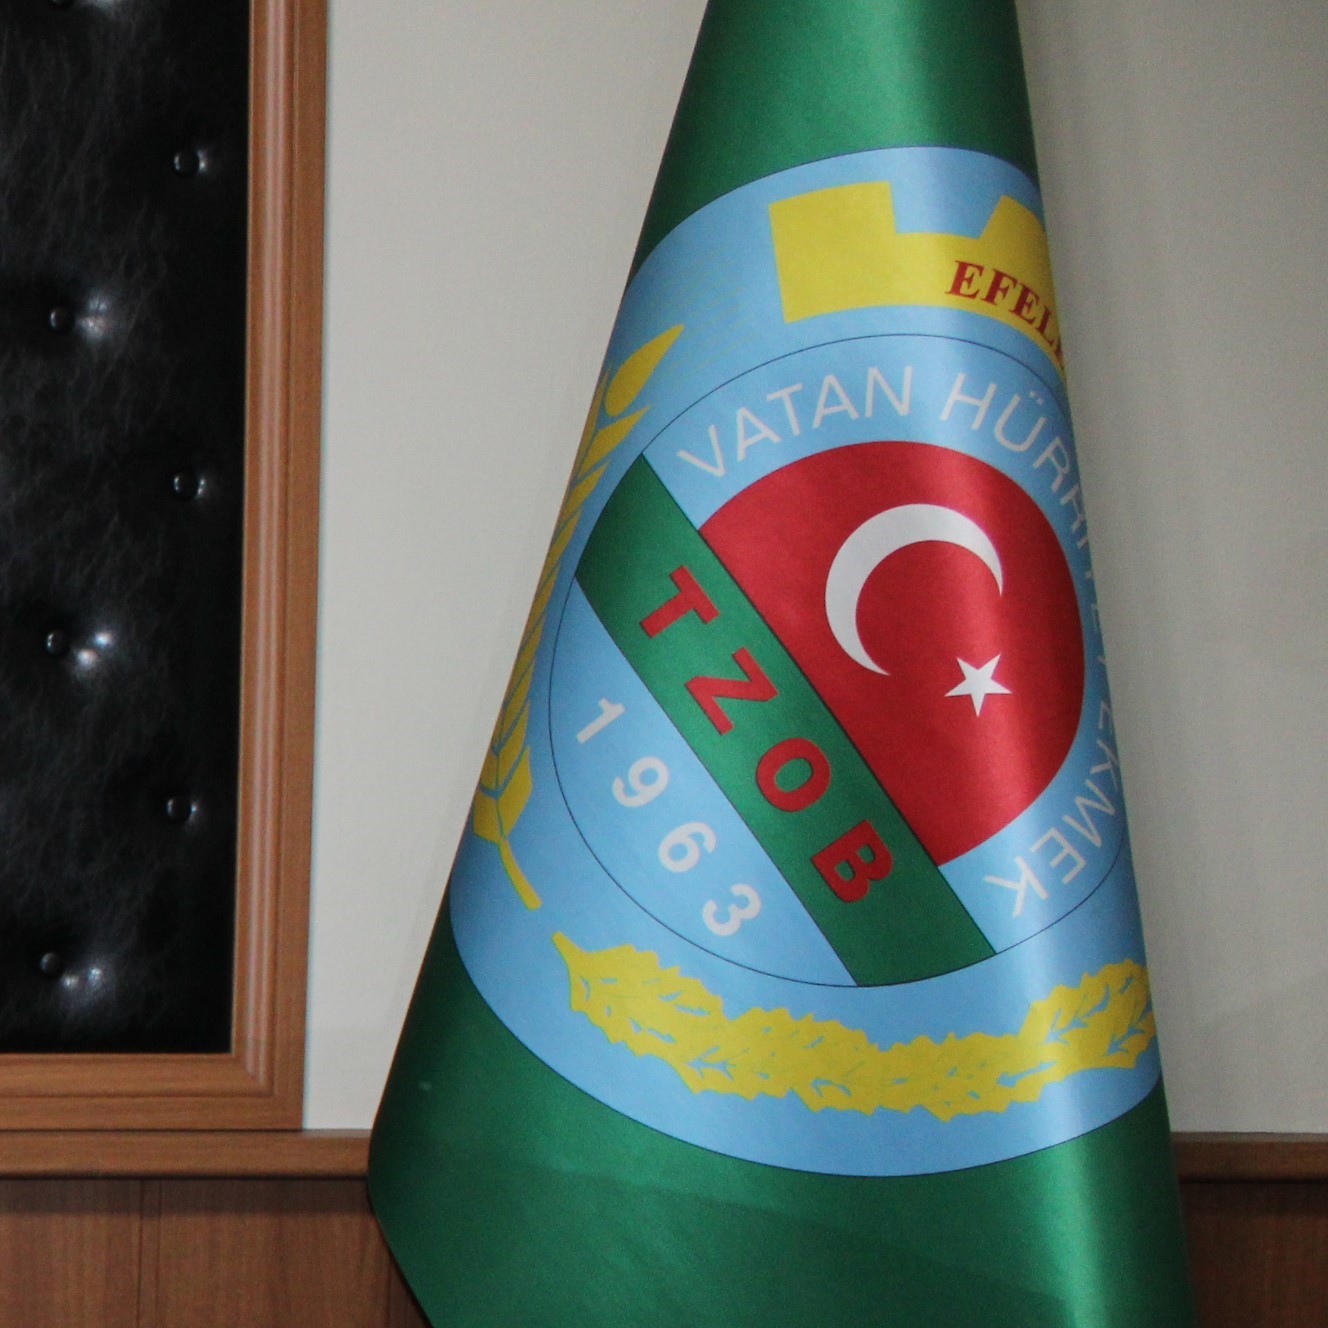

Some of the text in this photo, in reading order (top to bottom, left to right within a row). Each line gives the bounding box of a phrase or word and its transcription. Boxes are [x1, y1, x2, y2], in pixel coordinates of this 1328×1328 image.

[676, 365, 914, 480] VATAN
[576, 697, 762, 937] 1963
[639, 565, 894, 903] TZOB
